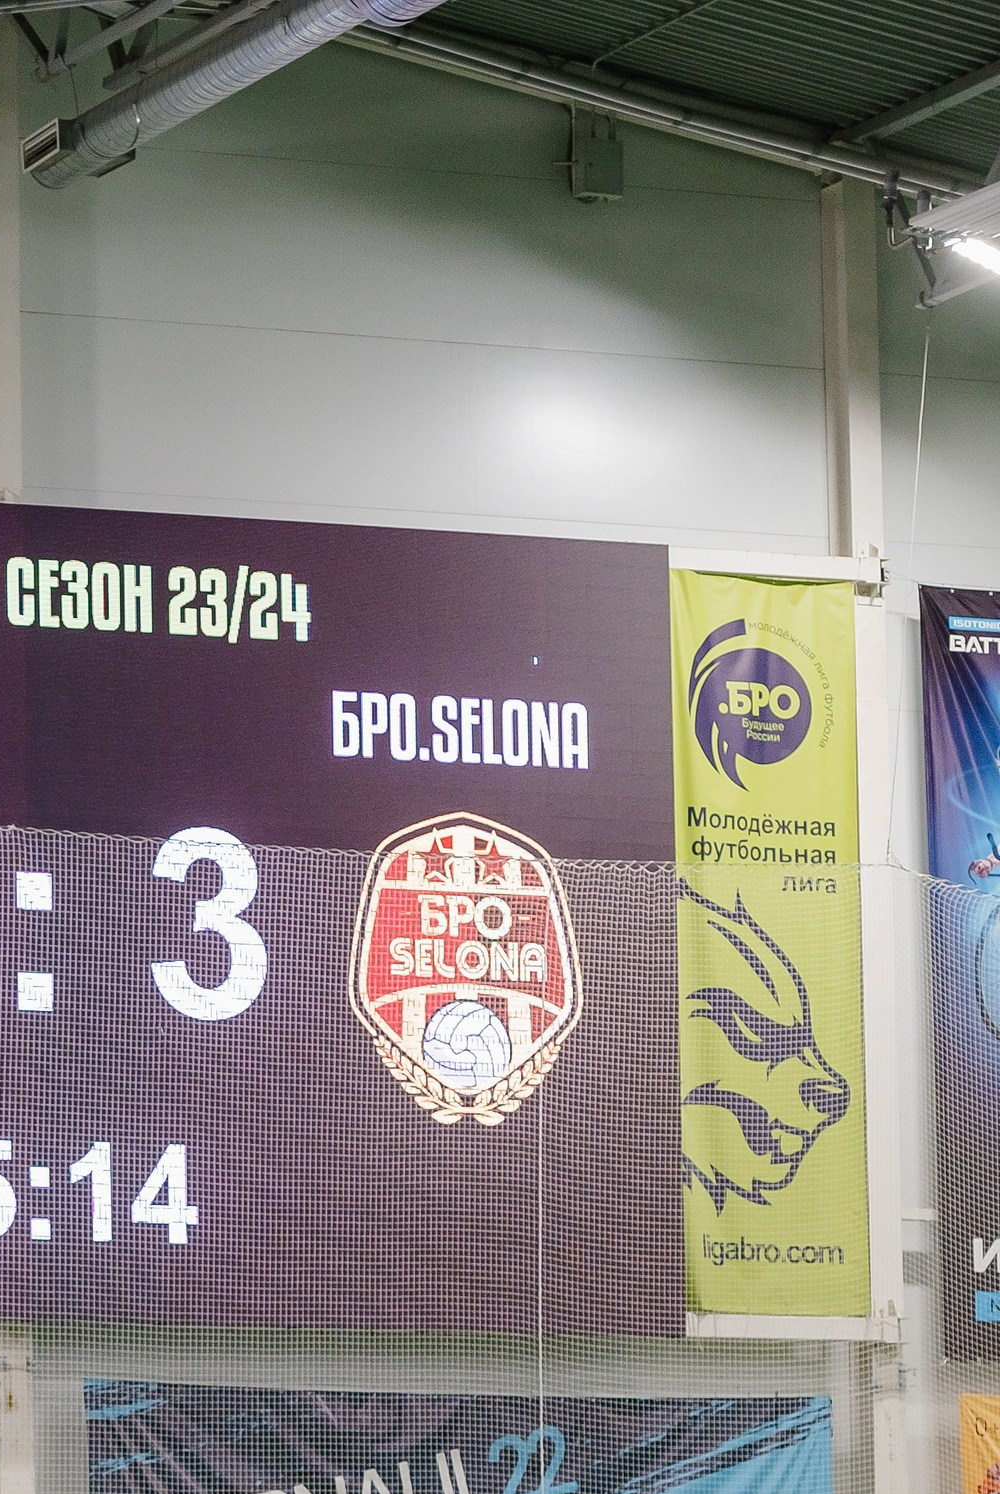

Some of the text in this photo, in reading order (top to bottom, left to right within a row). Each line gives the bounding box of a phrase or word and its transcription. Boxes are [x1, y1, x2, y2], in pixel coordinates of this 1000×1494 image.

[6, 556, 153, 634] СЕЗОН
[167, 565, 312, 644] 23/24
[718, 680, 800, 720] .БРО
[332, 690, 589, 770] БРО.SELONA
[742, 717, 785, 732] Будущее
[746, 729, 780, 742] России
[687, 806, 836, 837] Молодёжная
[691, 835, 836, 865] футбольная
[782, 875, 837, 894] лига
[150, 825, 268, 1021] 3
[389, 937, 547, 983] SELONA
[702, 1234, 845, 1266] ligabro.com
